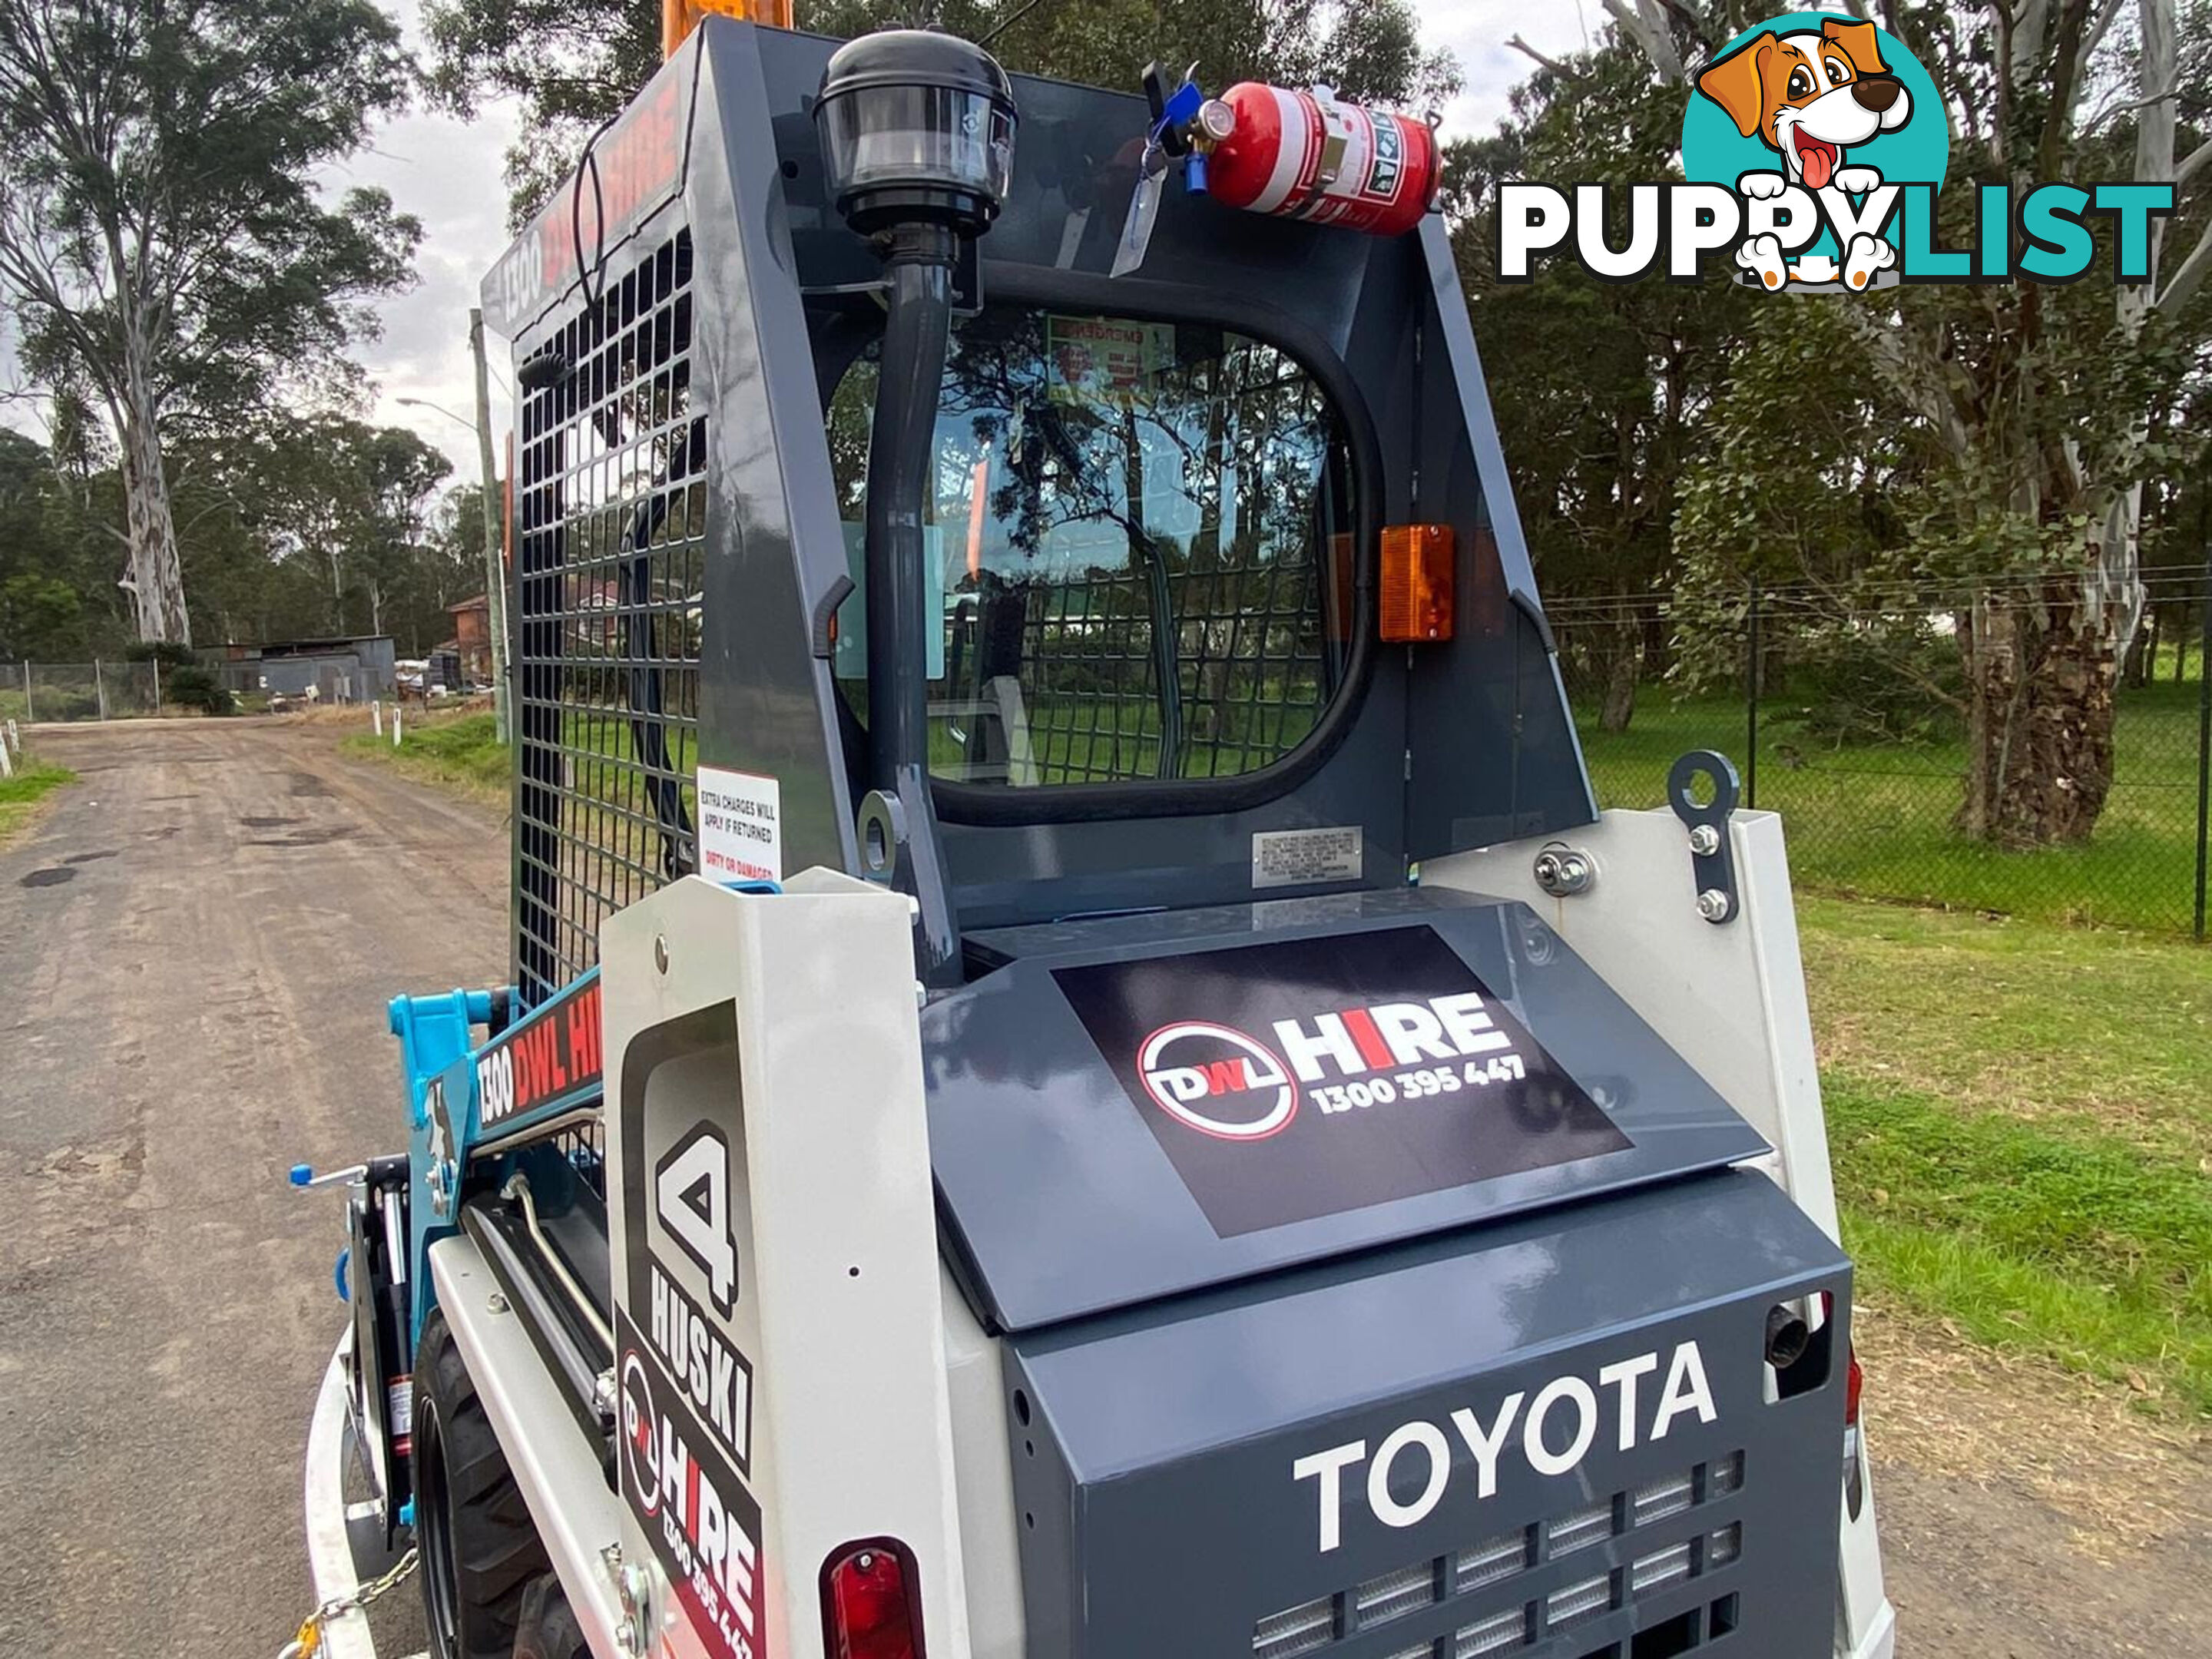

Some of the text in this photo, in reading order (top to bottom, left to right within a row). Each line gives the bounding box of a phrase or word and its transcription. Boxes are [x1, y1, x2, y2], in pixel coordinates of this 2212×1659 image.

[701, 790, 775, 821] EXTRA CHARGES WILL
[704, 813, 773, 844] APPLY IF RETURNED
[706, 850, 724, 868] DIRTY
[725, 856, 735, 873] OR
[477, 1045, 513, 1124] 1300
[513, 1015, 566, 1107] DWL
[1272, 992, 1512, 1083] HIRE
[1145, 1058, 1288, 1101] DWL
[1308, 1054, 1528, 1115] 1300 395 447
[657, 1134, 734, 1306] 4
[651, 1264, 749, 1461] HUSKI
[1293, 1340, 1718, 1553] TOYOTA
[662, 1505, 691, 1577] 1300
[663, 1414, 755, 1637] HIRE
